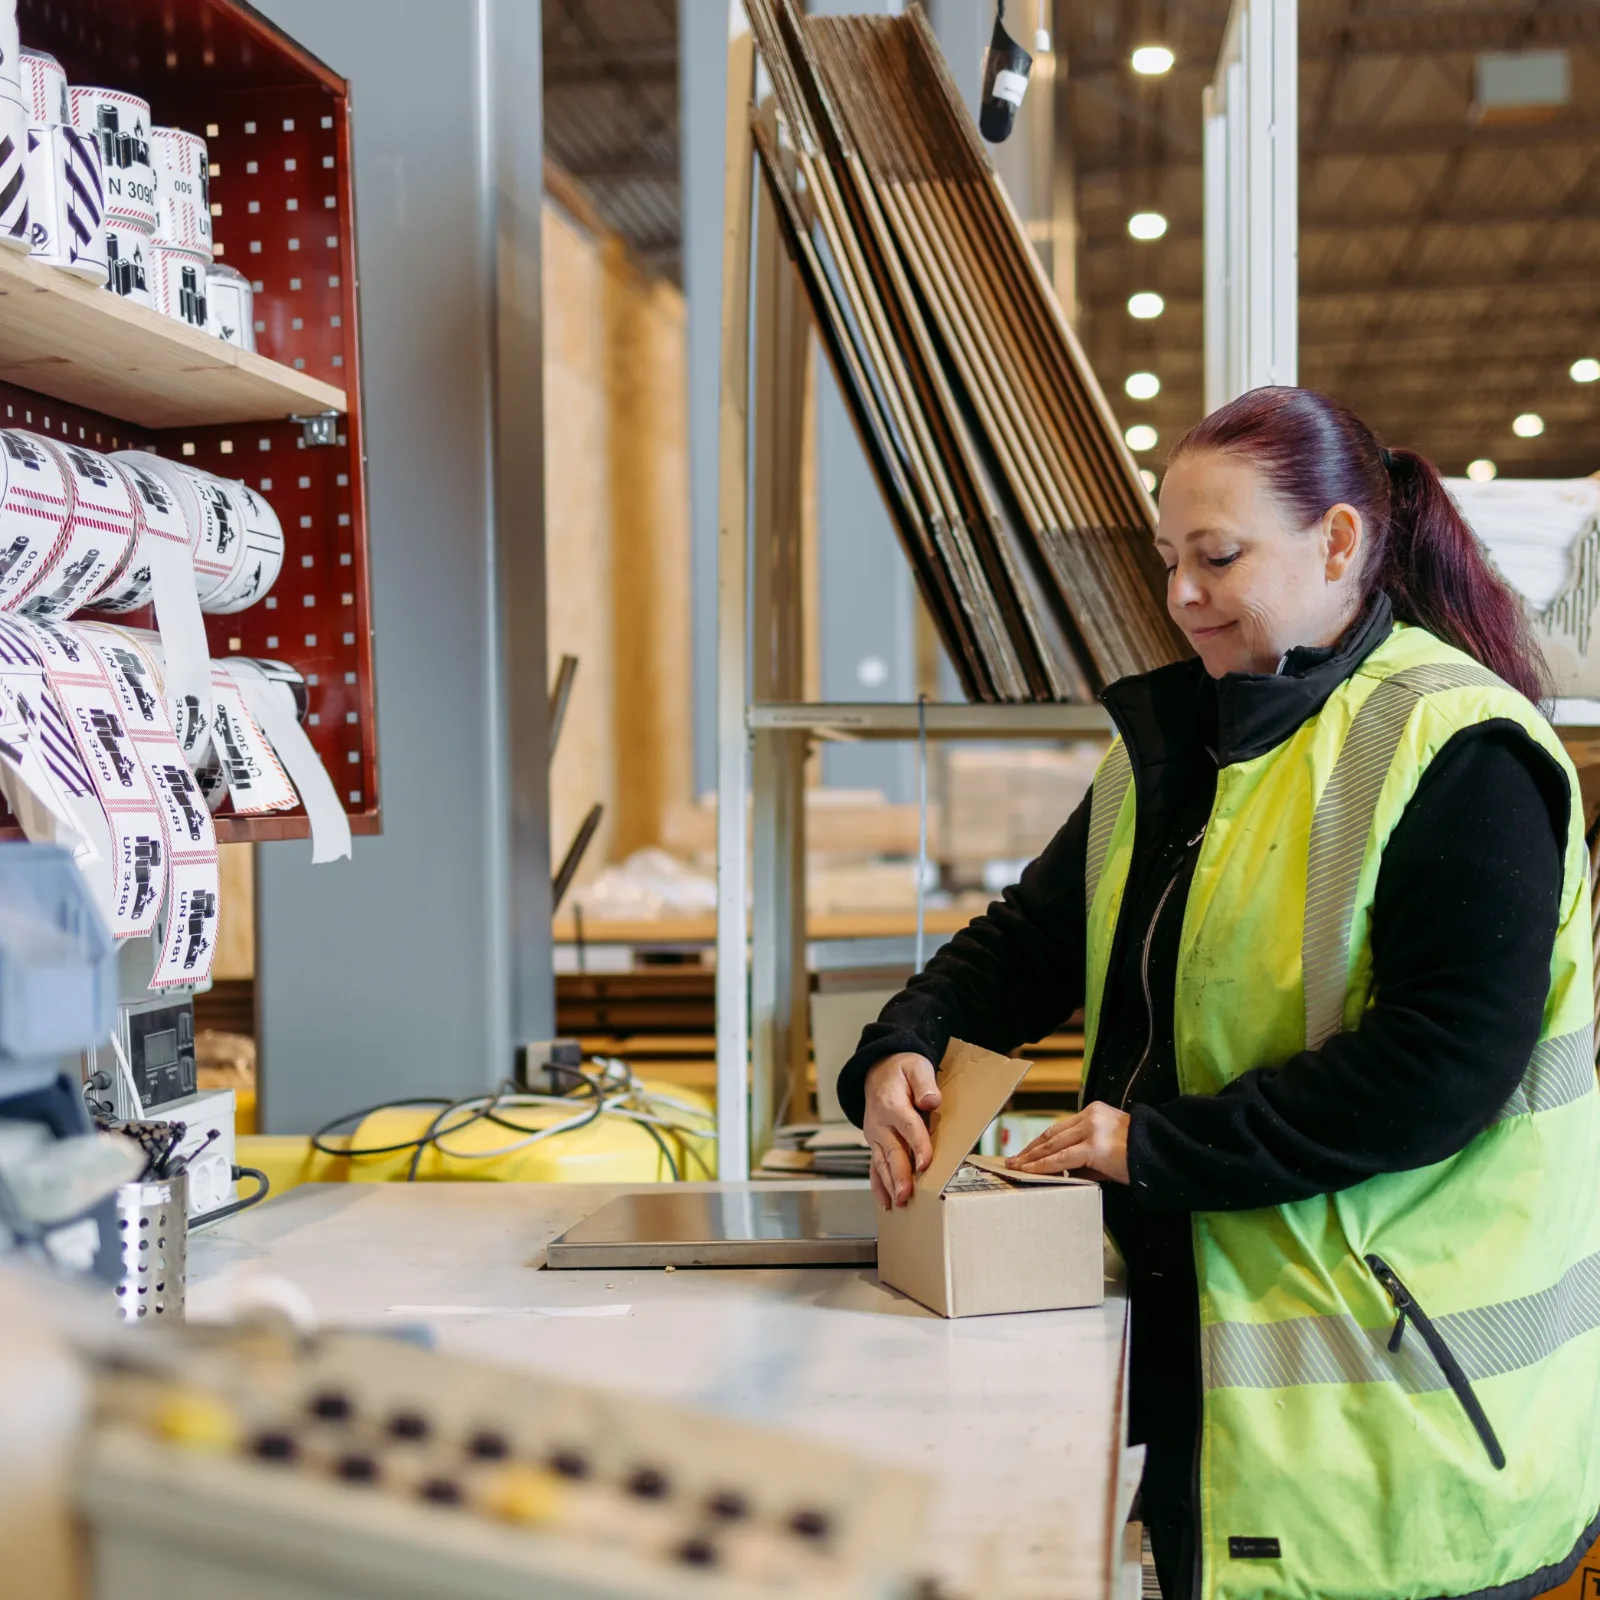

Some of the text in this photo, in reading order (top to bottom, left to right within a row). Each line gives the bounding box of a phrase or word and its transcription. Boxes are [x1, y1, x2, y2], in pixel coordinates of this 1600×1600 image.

[108, 177, 121, 196] N
[6, 550, 38, 586] 3480
[52, 563, 106, 615] UN 3481
[100, 646, 133, 711] UN 3481
[76, 707, 111, 782] UN 3480
[232, 717, 262, 778] UN 3091
[151, 765, 182, 832] UN 3481
[118, 837, 131, 916] UN 3480
[170, 891, 187, 963] UN 3481
